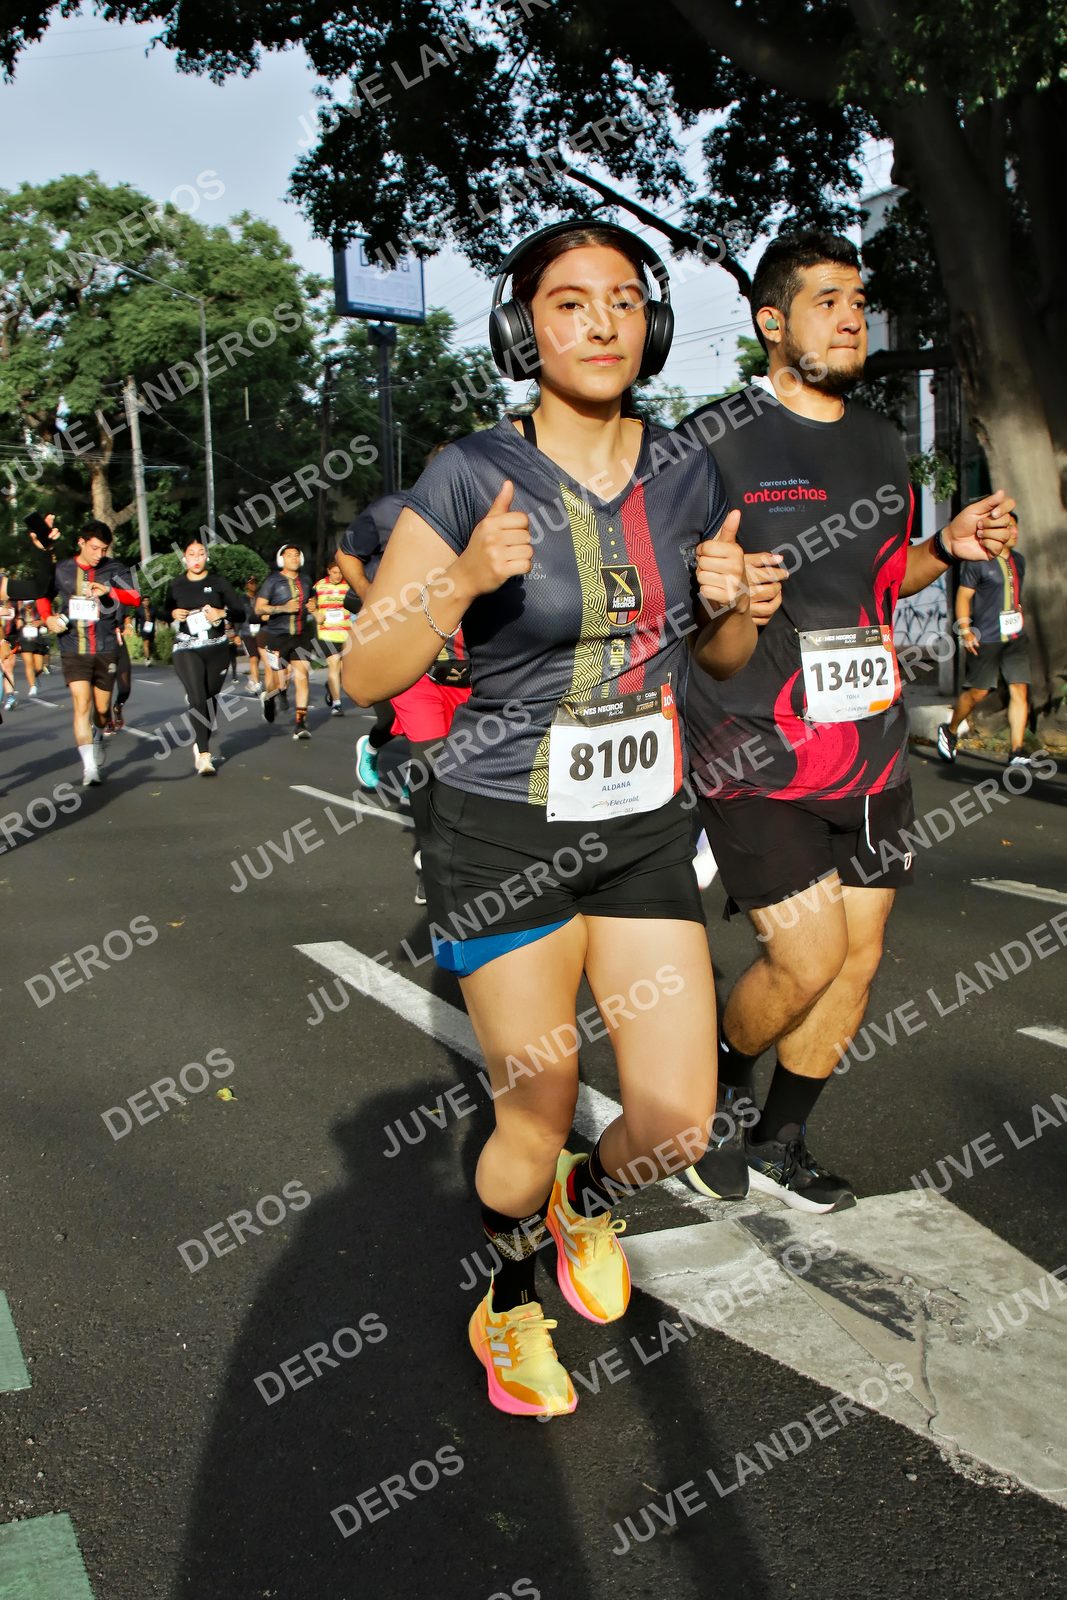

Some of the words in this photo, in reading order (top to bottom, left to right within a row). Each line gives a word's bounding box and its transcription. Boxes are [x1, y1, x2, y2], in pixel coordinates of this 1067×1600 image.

[743, 486, 827, 504] antorchas
[810, 657, 889, 692] 13492
[597, 702, 624, 713] NEGROS
[569, 730, 658, 781] 8100
[602, 780, 631, 791] ALDANA
